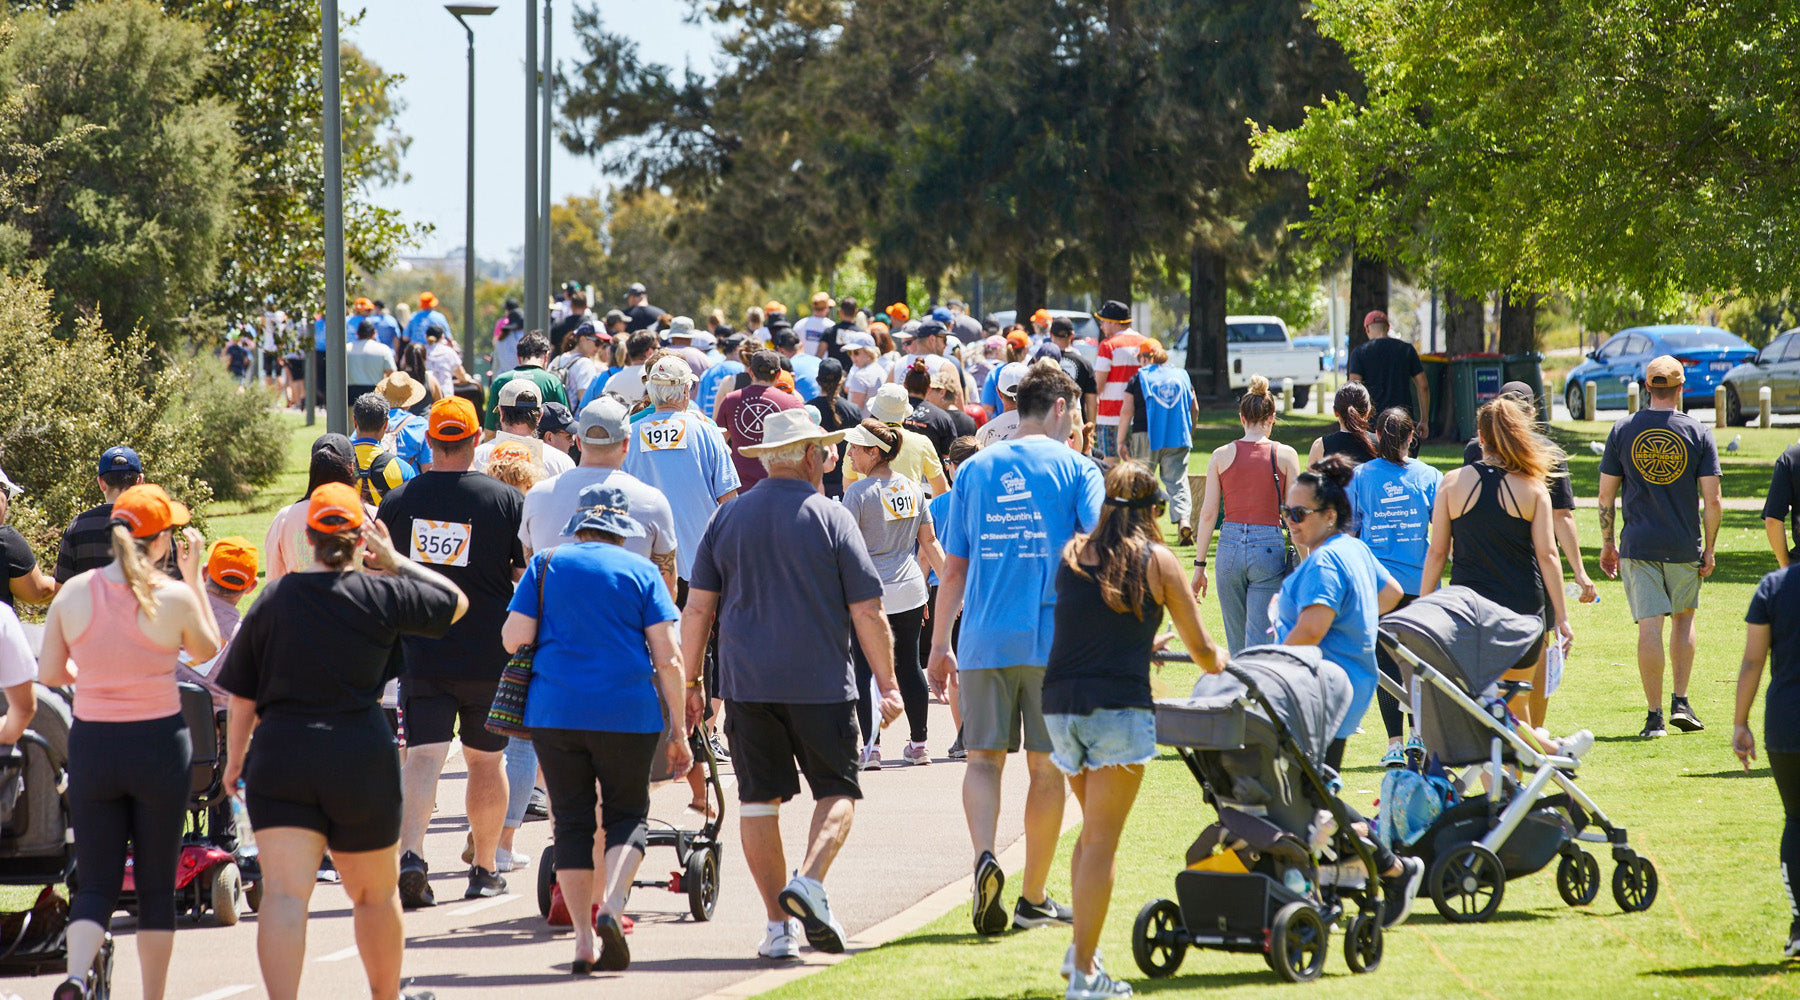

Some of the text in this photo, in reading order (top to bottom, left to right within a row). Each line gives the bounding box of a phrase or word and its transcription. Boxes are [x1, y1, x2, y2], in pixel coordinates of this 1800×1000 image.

[647, 429, 679, 444] 1912
[1635, 453, 1684, 461] INDEPENDENT
[891, 496, 913, 512] 1911
[417, 535, 463, 556] 3567
